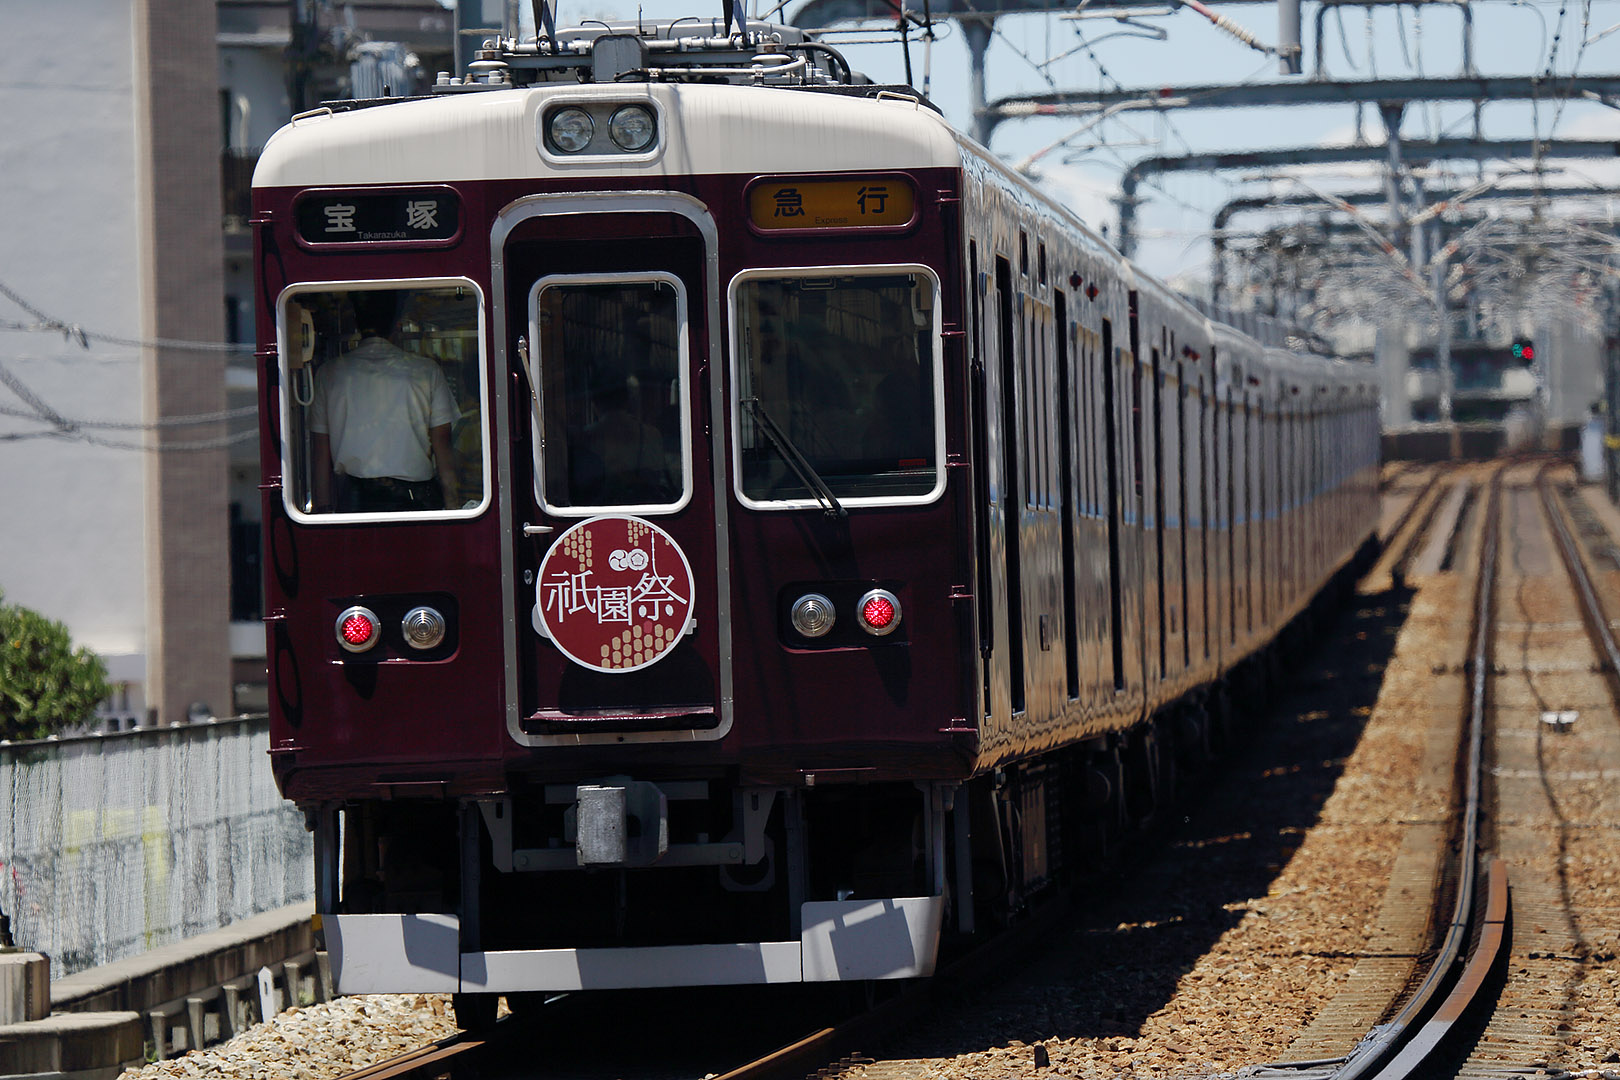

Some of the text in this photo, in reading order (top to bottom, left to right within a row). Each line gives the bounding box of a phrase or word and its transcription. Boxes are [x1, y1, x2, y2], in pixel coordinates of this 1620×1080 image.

[324, 201, 439, 232] 宝塚
[773, 186, 889, 217] 急行
[357, 231, 407, 240] Takarazuka
[815, 216, 849, 225] Express
[543, 530, 688, 626] 祇園祭
